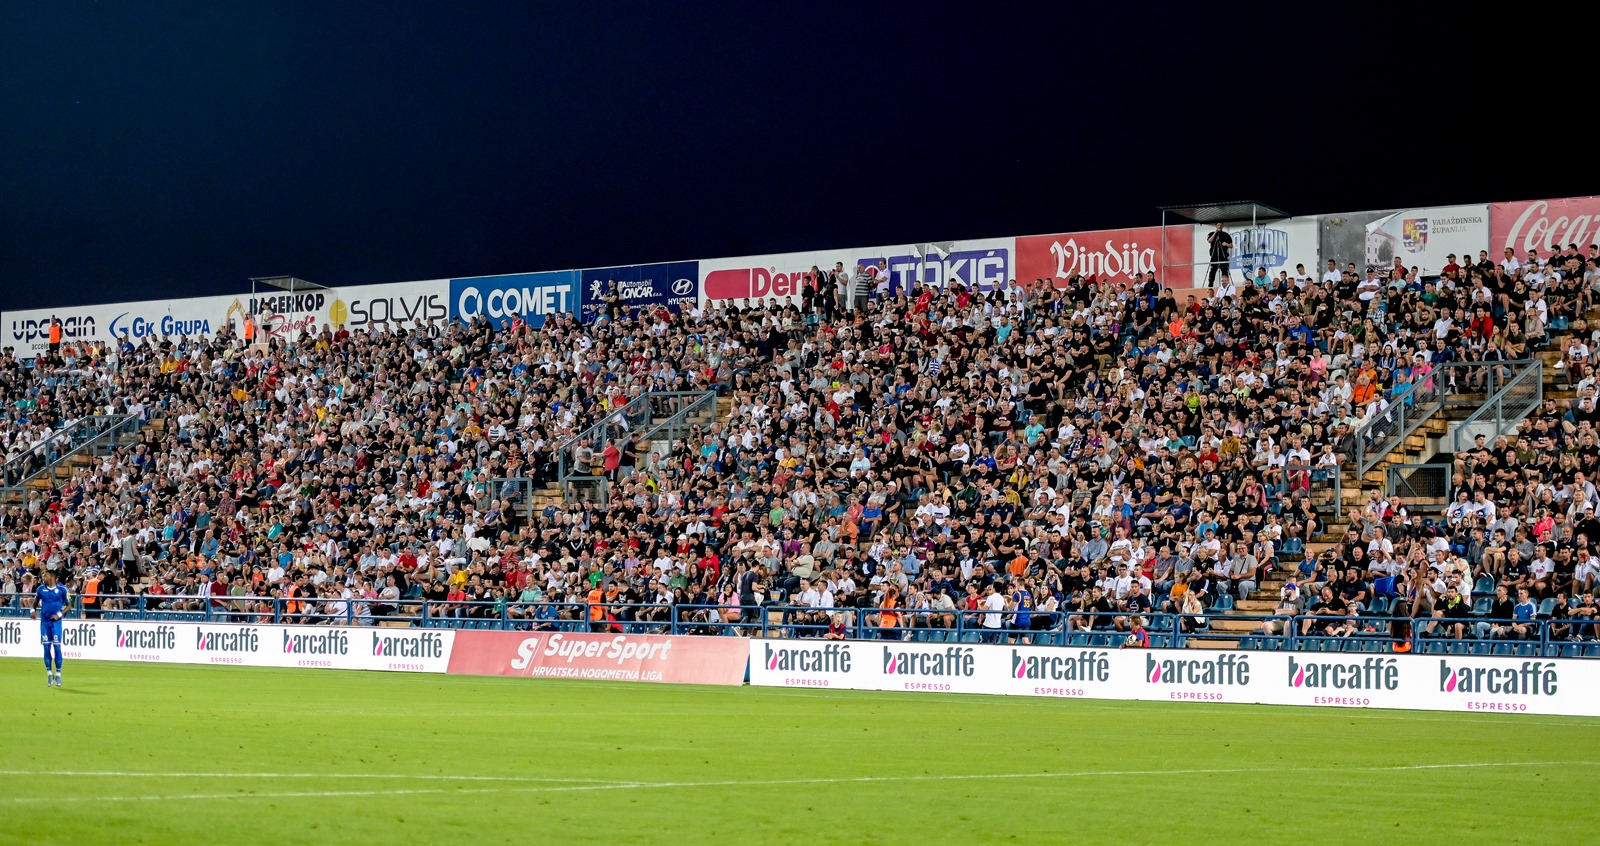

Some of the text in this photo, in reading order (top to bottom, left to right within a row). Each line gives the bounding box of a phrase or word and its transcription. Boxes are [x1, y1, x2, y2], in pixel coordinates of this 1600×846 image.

[1432, 216, 1483, 226] VARAŽDINSKA
[1432, 225, 1467, 234] ŽUPANIJA
[1228, 225, 1288, 258] ARAŽDIN
[892, 251, 1004, 291] TOKIĆ
[1049, 238, 1157, 279] Vindija
[249, 293, 325, 315] BAGERKOP
[350, 295, 447, 326] SOLVIS
[487, 284, 571, 319] COMET
[117, 625, 175, 649] barcaffé
[197, 627, 258, 652] barcaffé
[284, 629, 348, 655] barcaffé
[373, 631, 442, 658] barcaffé
[544, 633, 672, 663] SuperSport
[211, 656, 243, 664] ESPRESSO
[389, 663, 424, 671] ESPRESSO
[766, 643, 851, 673] barcaffé
[884, 646, 974, 676] barcaffé
[1012, 648, 1109, 682] barcaffé
[1147, 653, 1250, 686] barcaffé
[532, 666, 663, 681] HRVATSKA NOGOMETNA LIGA
[785, 678, 829, 687] ESPRESSO
[1289, 656, 1398, 690] barcaffé
[1440, 659, 1558, 696] barcaffé
[904, 682, 951, 691] ESPRESSO
[1034, 687, 1084, 697] ESPRESSO
[1170, 691, 1223, 701] ESPRESSO
[1313, 696, 1370, 706] ESPRESSO
[1467, 701, 1527, 712] ESPRESSO
